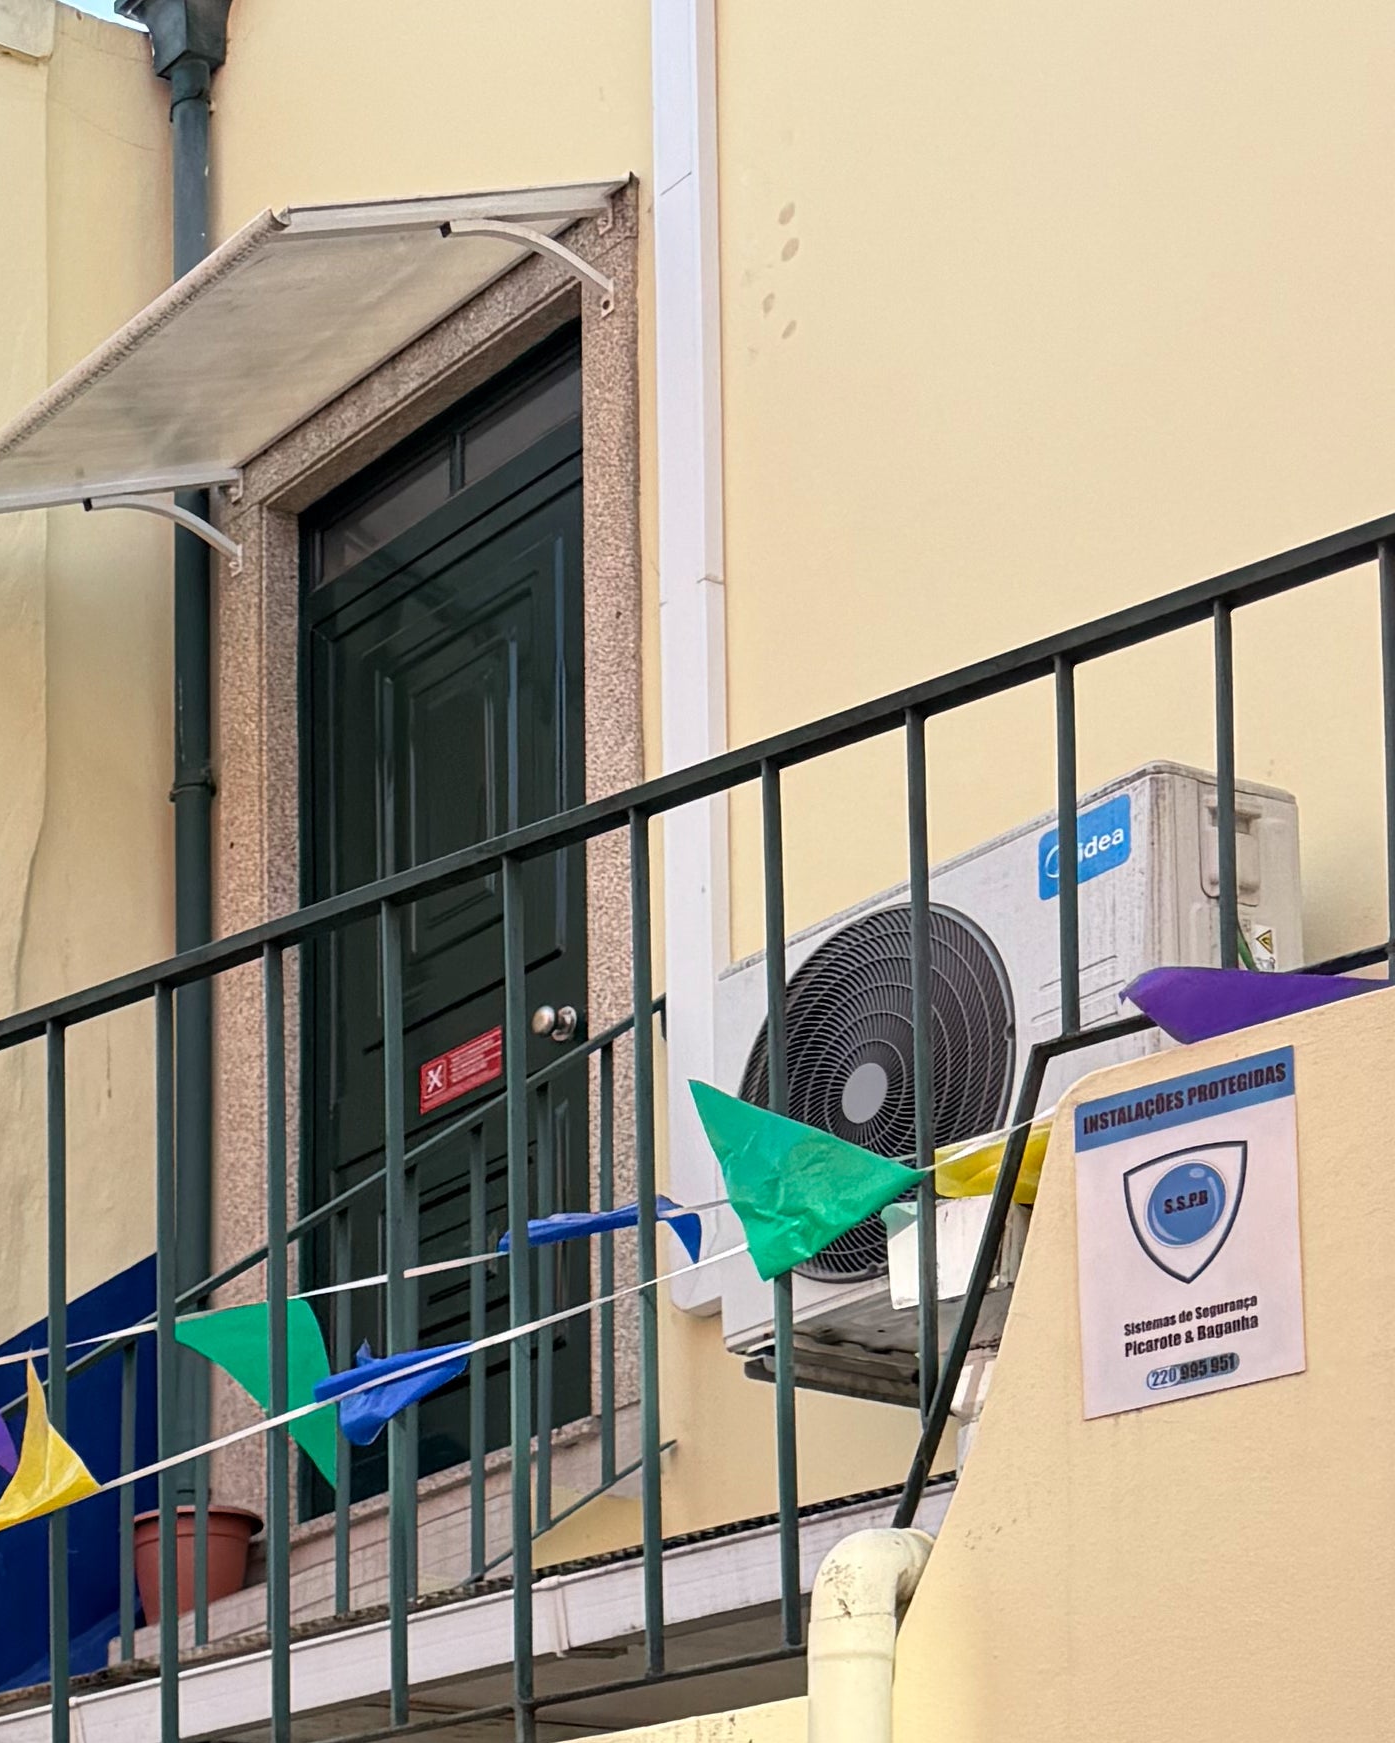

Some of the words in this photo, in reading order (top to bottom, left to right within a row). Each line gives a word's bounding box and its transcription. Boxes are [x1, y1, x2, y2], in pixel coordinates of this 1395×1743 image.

[1083, 1090, 1185, 1135] INSTALAÇÕES
[1187, 1062, 1287, 1106] PROTEGIDAS
[1123, 1315, 1177, 1337] Sistemas
[1178, 1310, 1193, 1324] de
[1195, 1295, 1258, 1320] Segurança
[1124, 1332, 1182, 1358] Picarote
[1184, 1330, 1195, 1344] &
[1197, 1315, 1259, 1341] Baganha
[1151, 1367, 1177, 1387] 220
